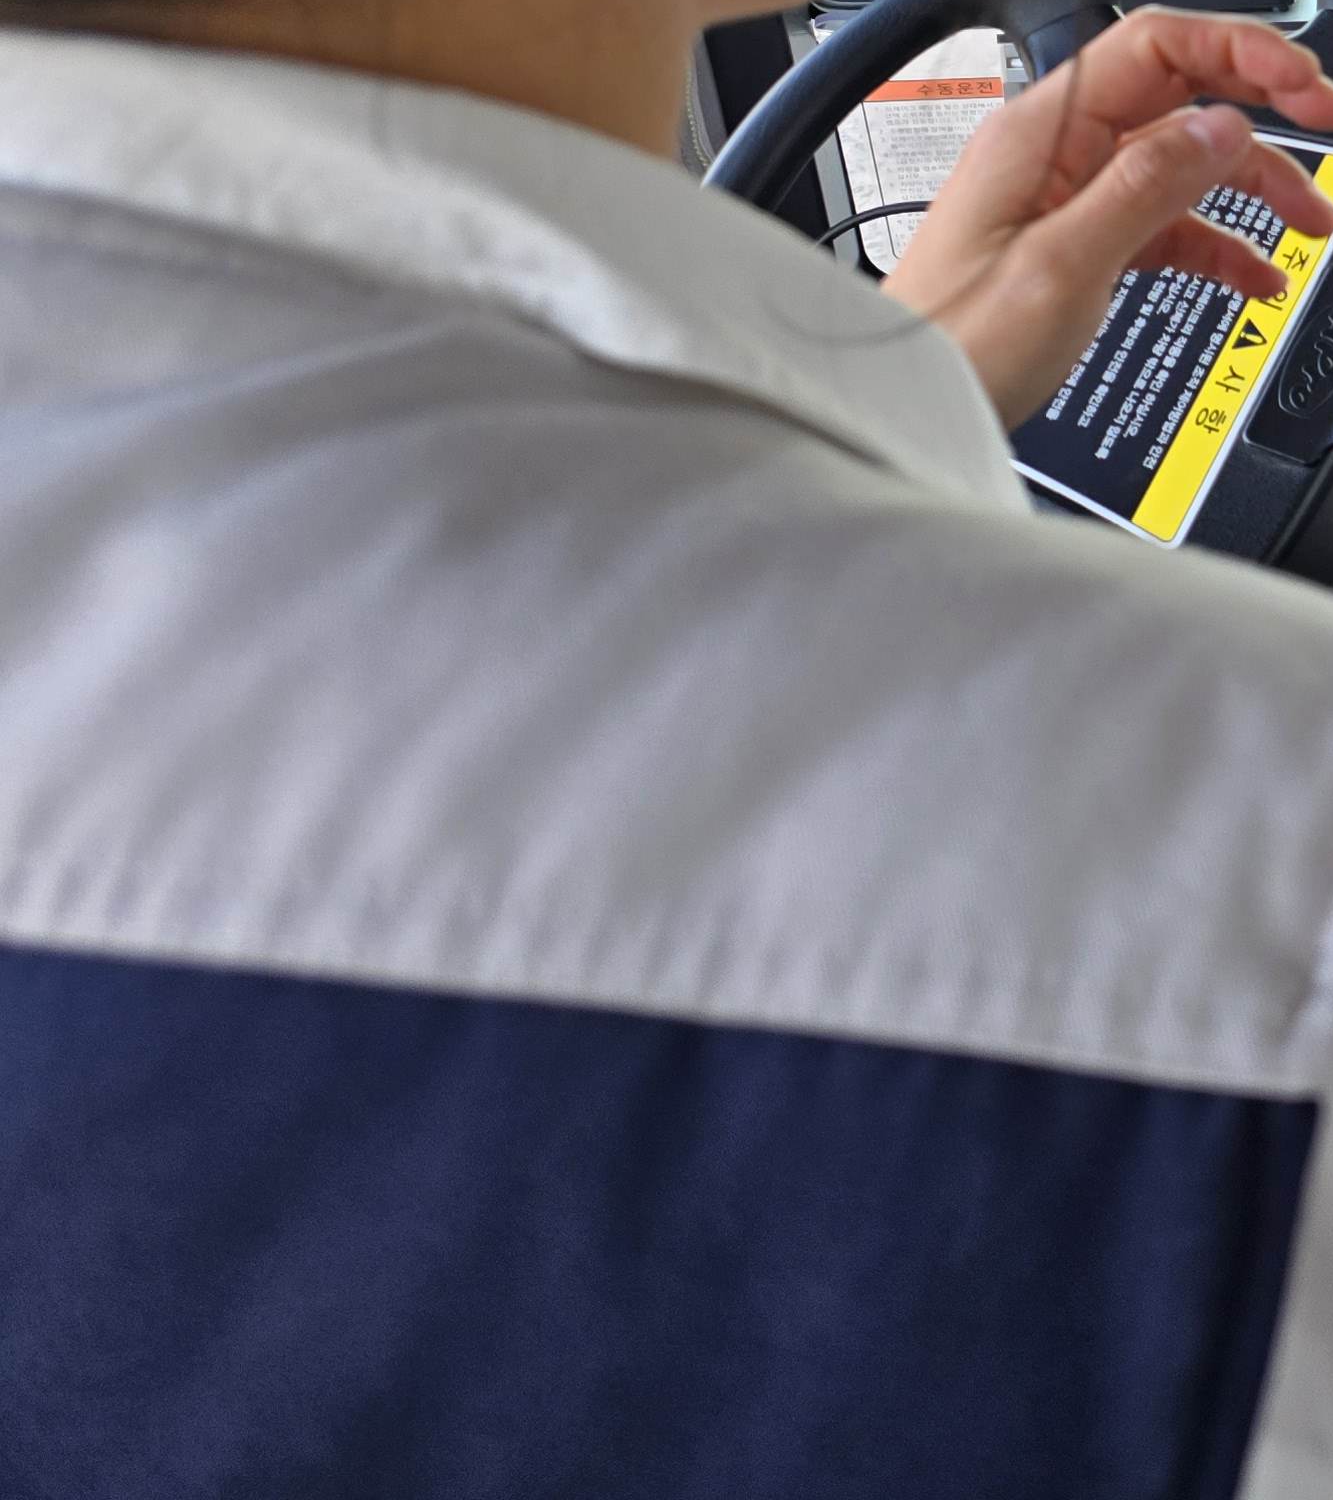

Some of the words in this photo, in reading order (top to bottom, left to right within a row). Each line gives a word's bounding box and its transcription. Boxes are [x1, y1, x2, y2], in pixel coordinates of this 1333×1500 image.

[916, 80, 994, 96] 수동운전
[1113, 390, 1140, 426] 나오지
[1196, 365, 1246, 434] 사항
[1142, 445, 1164, 470] 안전
